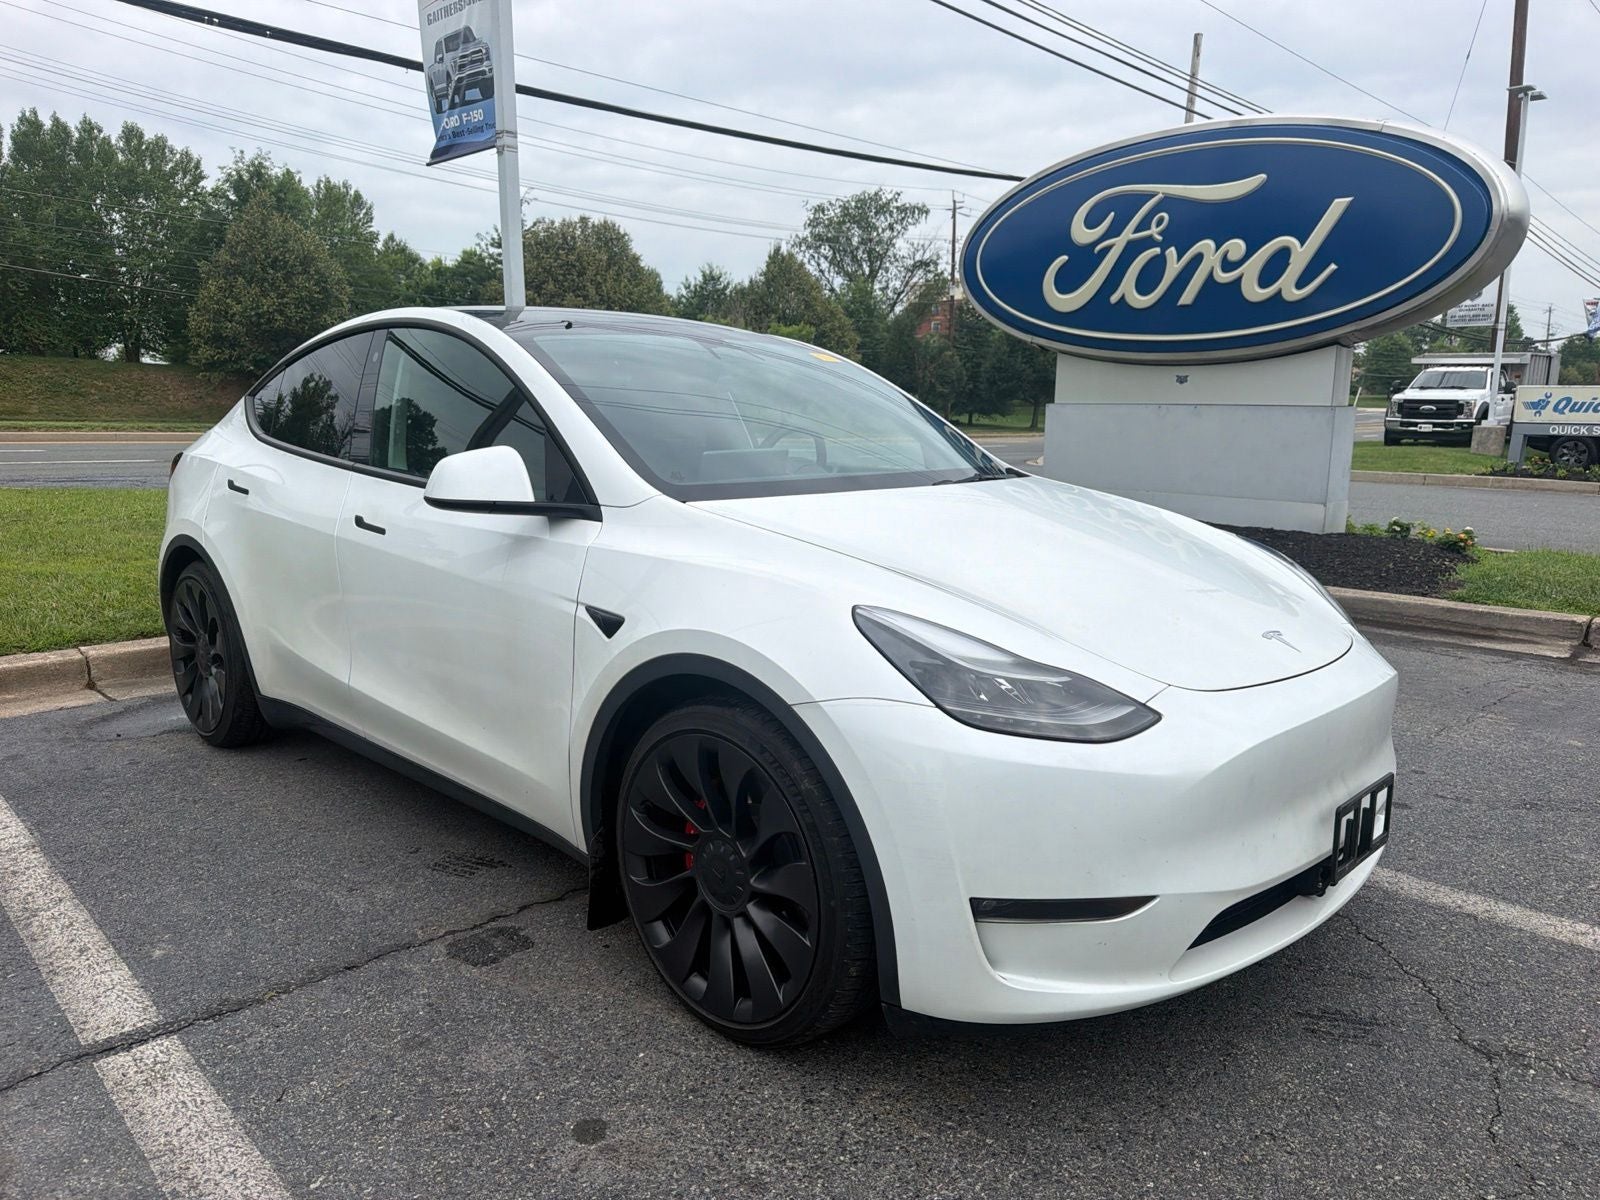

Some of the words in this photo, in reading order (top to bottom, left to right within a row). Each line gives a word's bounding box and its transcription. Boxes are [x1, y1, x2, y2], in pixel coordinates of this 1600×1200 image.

[426, 0, 481, 26] GAITHERS
[442, 114, 460, 129] ORD
[462, 108, 484, 125] F-150
[1042, 173, 1354, 313] Ford
[1549, 425, 1588, 435] QUICK
